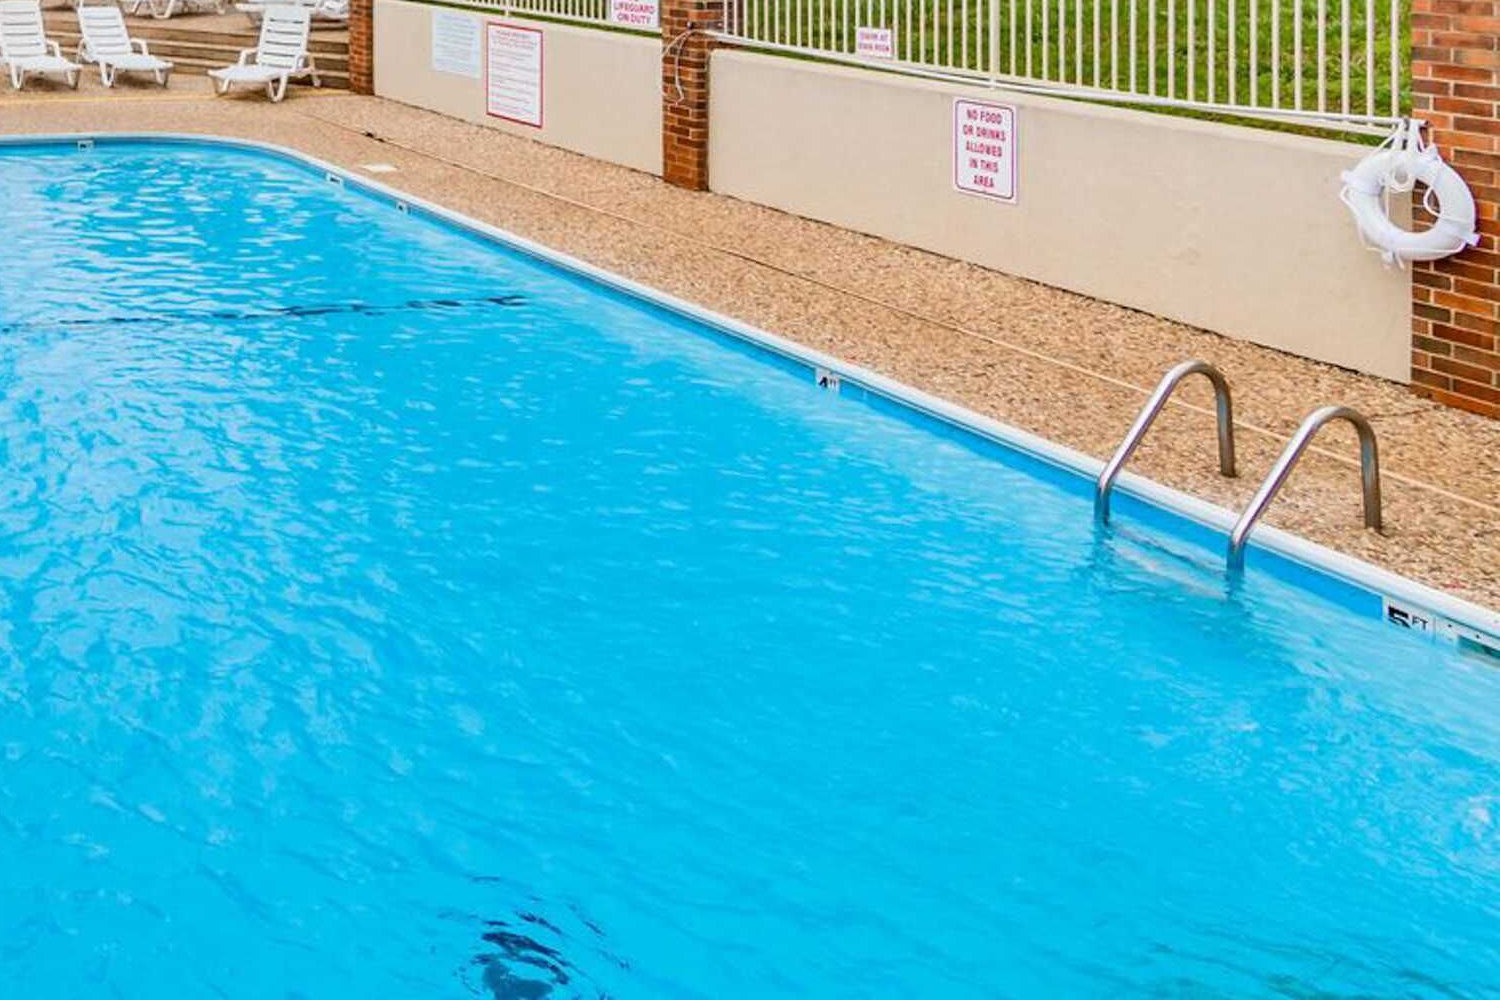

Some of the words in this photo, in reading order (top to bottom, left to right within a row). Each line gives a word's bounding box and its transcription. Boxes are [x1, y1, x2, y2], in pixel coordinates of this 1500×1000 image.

[613, 1, 656, 14] LIFEGUARD
[617, 12, 629, 21] ON
[630, 13, 651, 25] DUTY
[966, 109, 978, 120] NO
[980, 111, 1002, 124] FOOD
[963, 124, 974, 135] OR
[976, 126, 1006, 141] DRINKS
[966, 141, 1003, 157] ALLOWED
[968, 158, 978, 169] IN
[980, 160, 999, 173] THIS
[973, 174, 995, 188] AREA
[1411, 616, 1429, 631] FT
